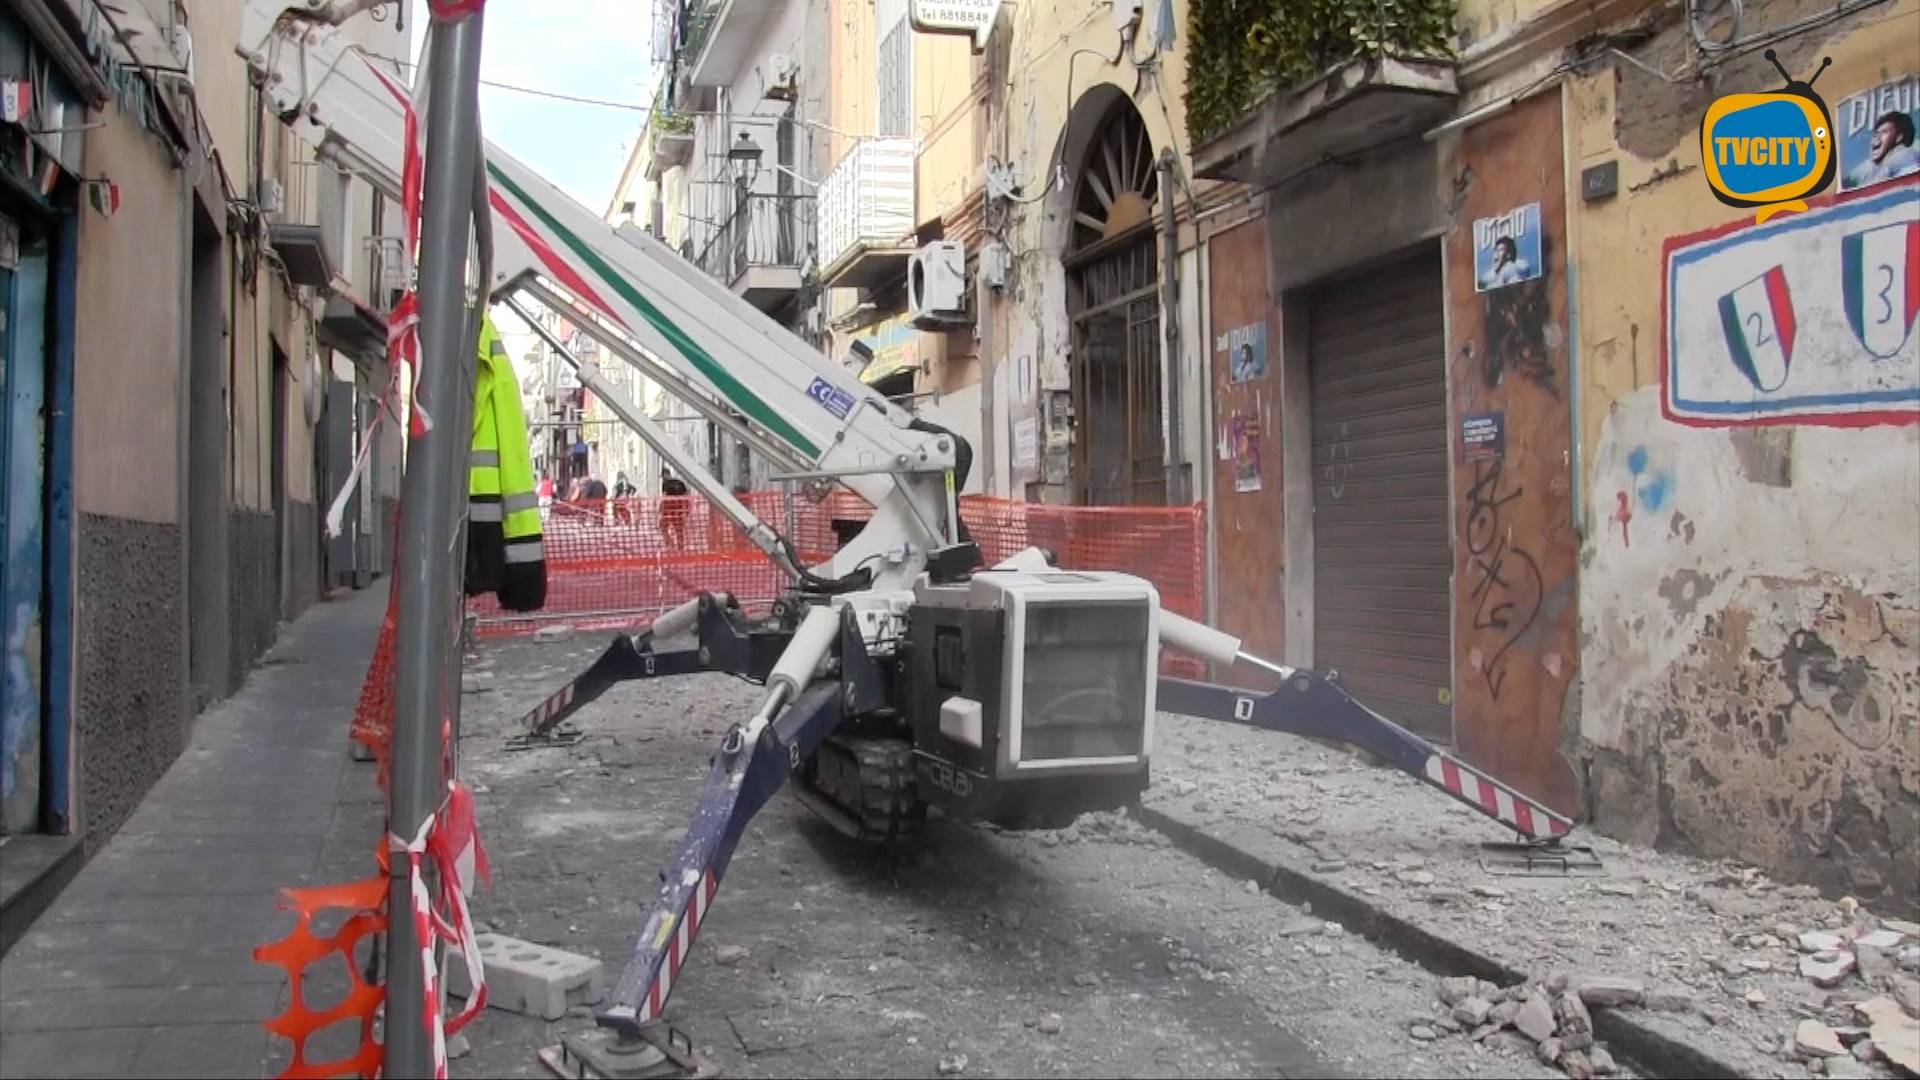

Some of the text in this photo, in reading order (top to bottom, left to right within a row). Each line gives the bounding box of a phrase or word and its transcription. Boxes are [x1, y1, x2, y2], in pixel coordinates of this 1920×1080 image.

[921, 8, 936, 20] Tel
[1876, 264, 1895, 325] 3
[1747, 313, 1771, 347] 2
